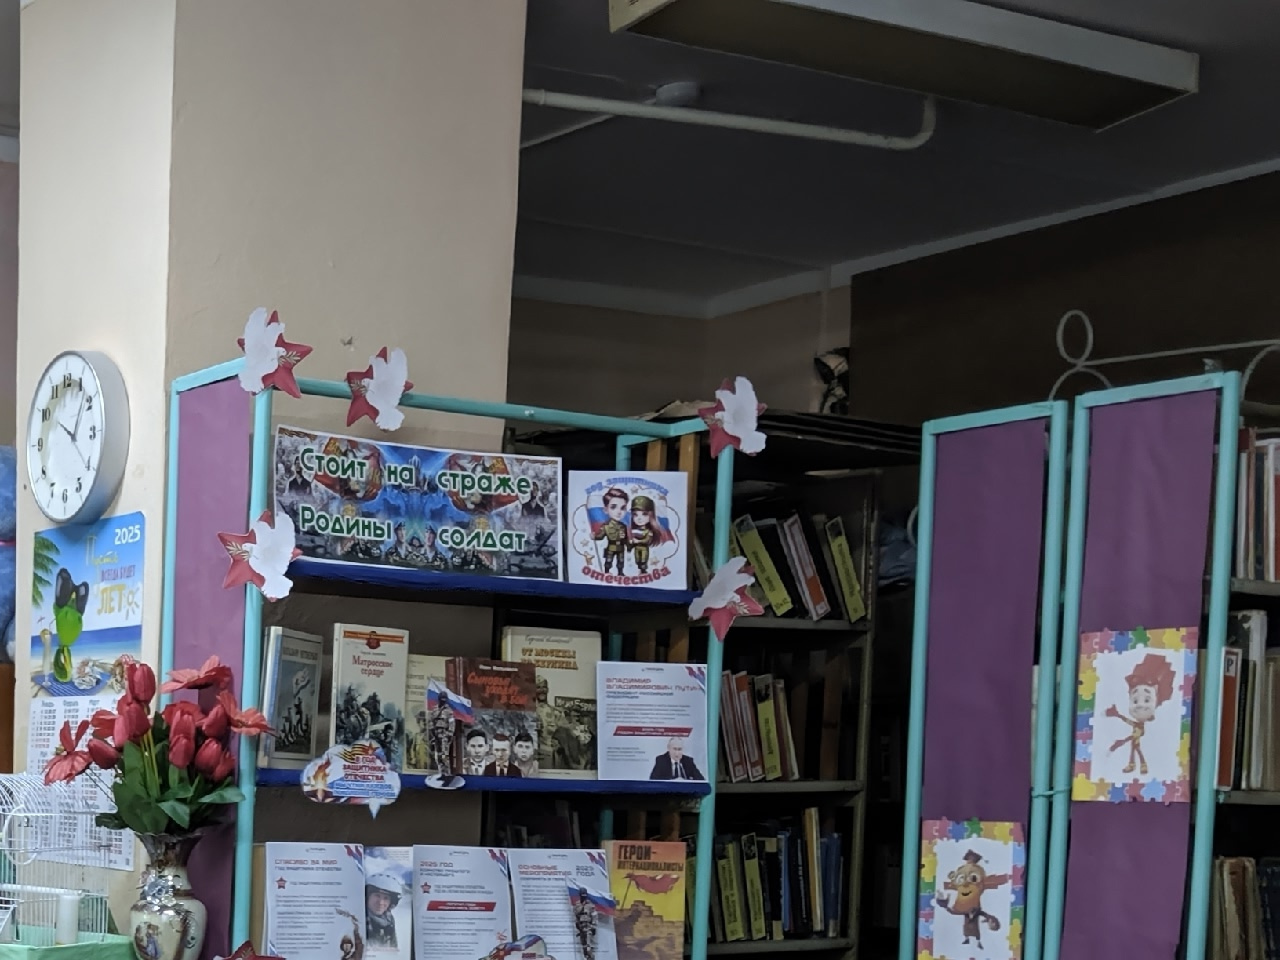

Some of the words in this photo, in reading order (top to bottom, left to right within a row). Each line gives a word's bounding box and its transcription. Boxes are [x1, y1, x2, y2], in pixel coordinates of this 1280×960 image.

[63, 372, 72, 388] 12
[78, 377, 83, 392] 1
[51, 384, 59, 400] 11
[85, 395, 93, 412] 2
[41, 407, 51, 423] 10
[89, 425, 97, 441] 3
[37, 437, 44, 452] 9
[84, 455, 91, 472] 4
[41, 465, 47, 480] 8
[299, 447, 368, 480] Стоит
[386, 463, 415, 487] на
[437, 470, 533, 497] страже
[50, 482, 56, 499] 7
[75, 477, 82, 493] 5
[62, 488, 68, 504] 6
[114, 525, 141, 545] 2025
[299, 505, 393, 540] Родины
[437, 524, 527, 553] солдат
[582, 565, 672, 586] отечества
